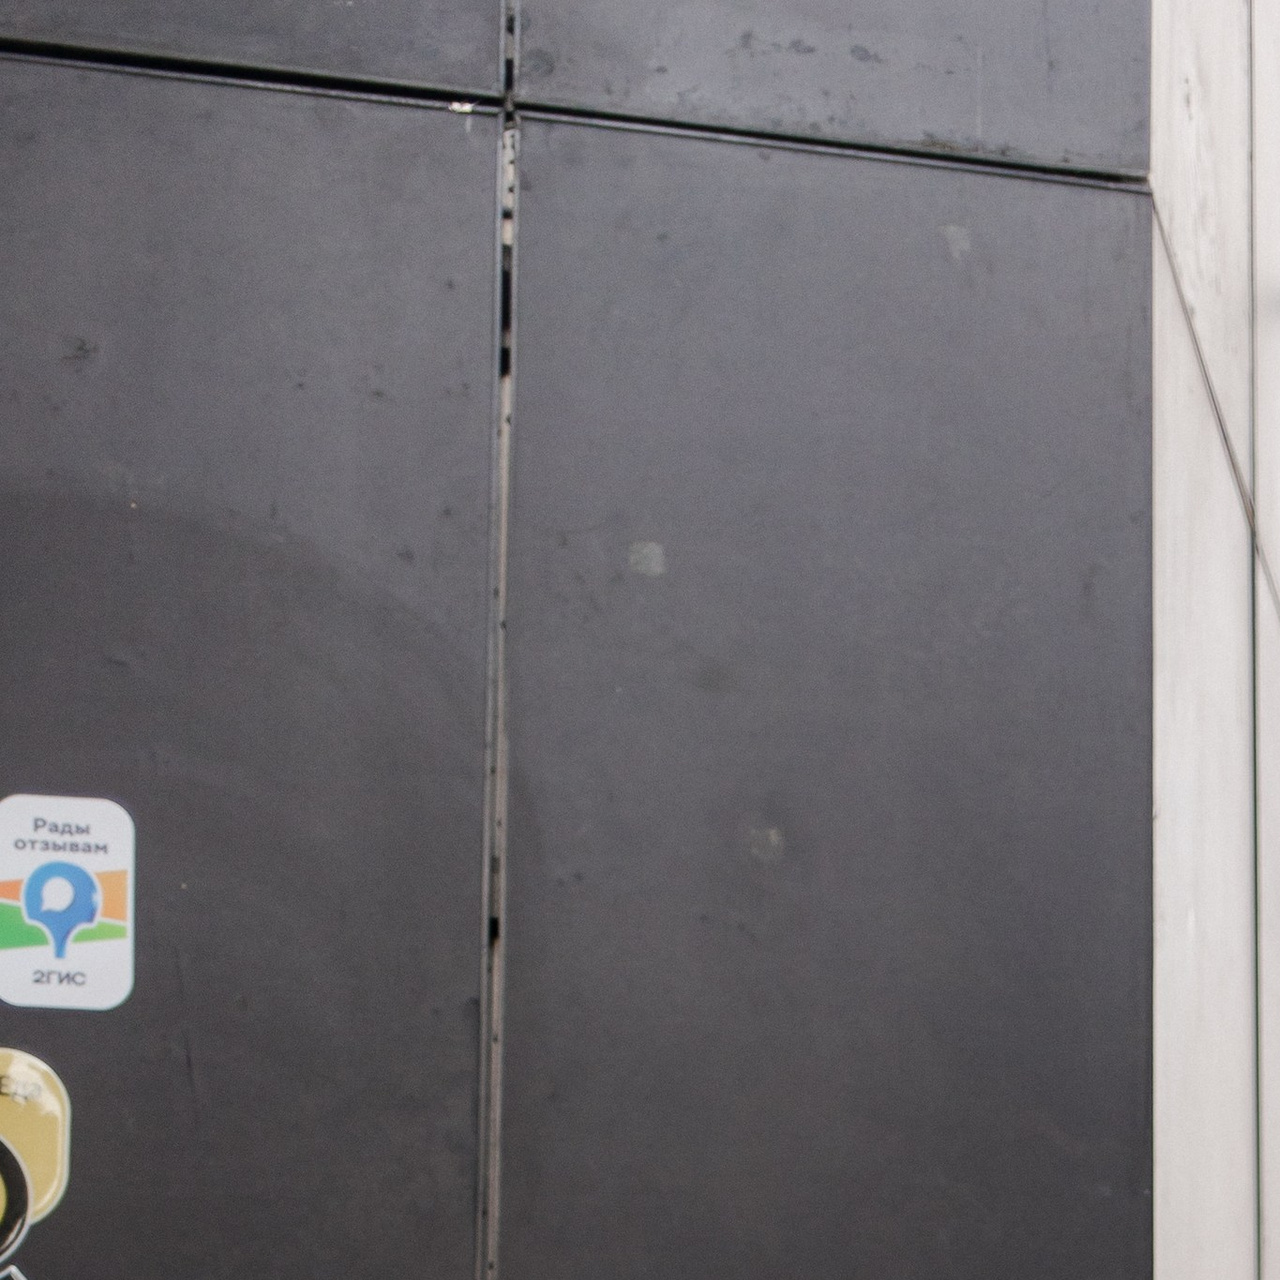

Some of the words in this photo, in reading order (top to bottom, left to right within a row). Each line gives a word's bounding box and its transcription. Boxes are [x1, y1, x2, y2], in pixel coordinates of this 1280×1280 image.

[33, 818, 91, 835] Рады
[14, 839, 109, 854] отзывам
[33, 970, 86, 986] 2ГИС
